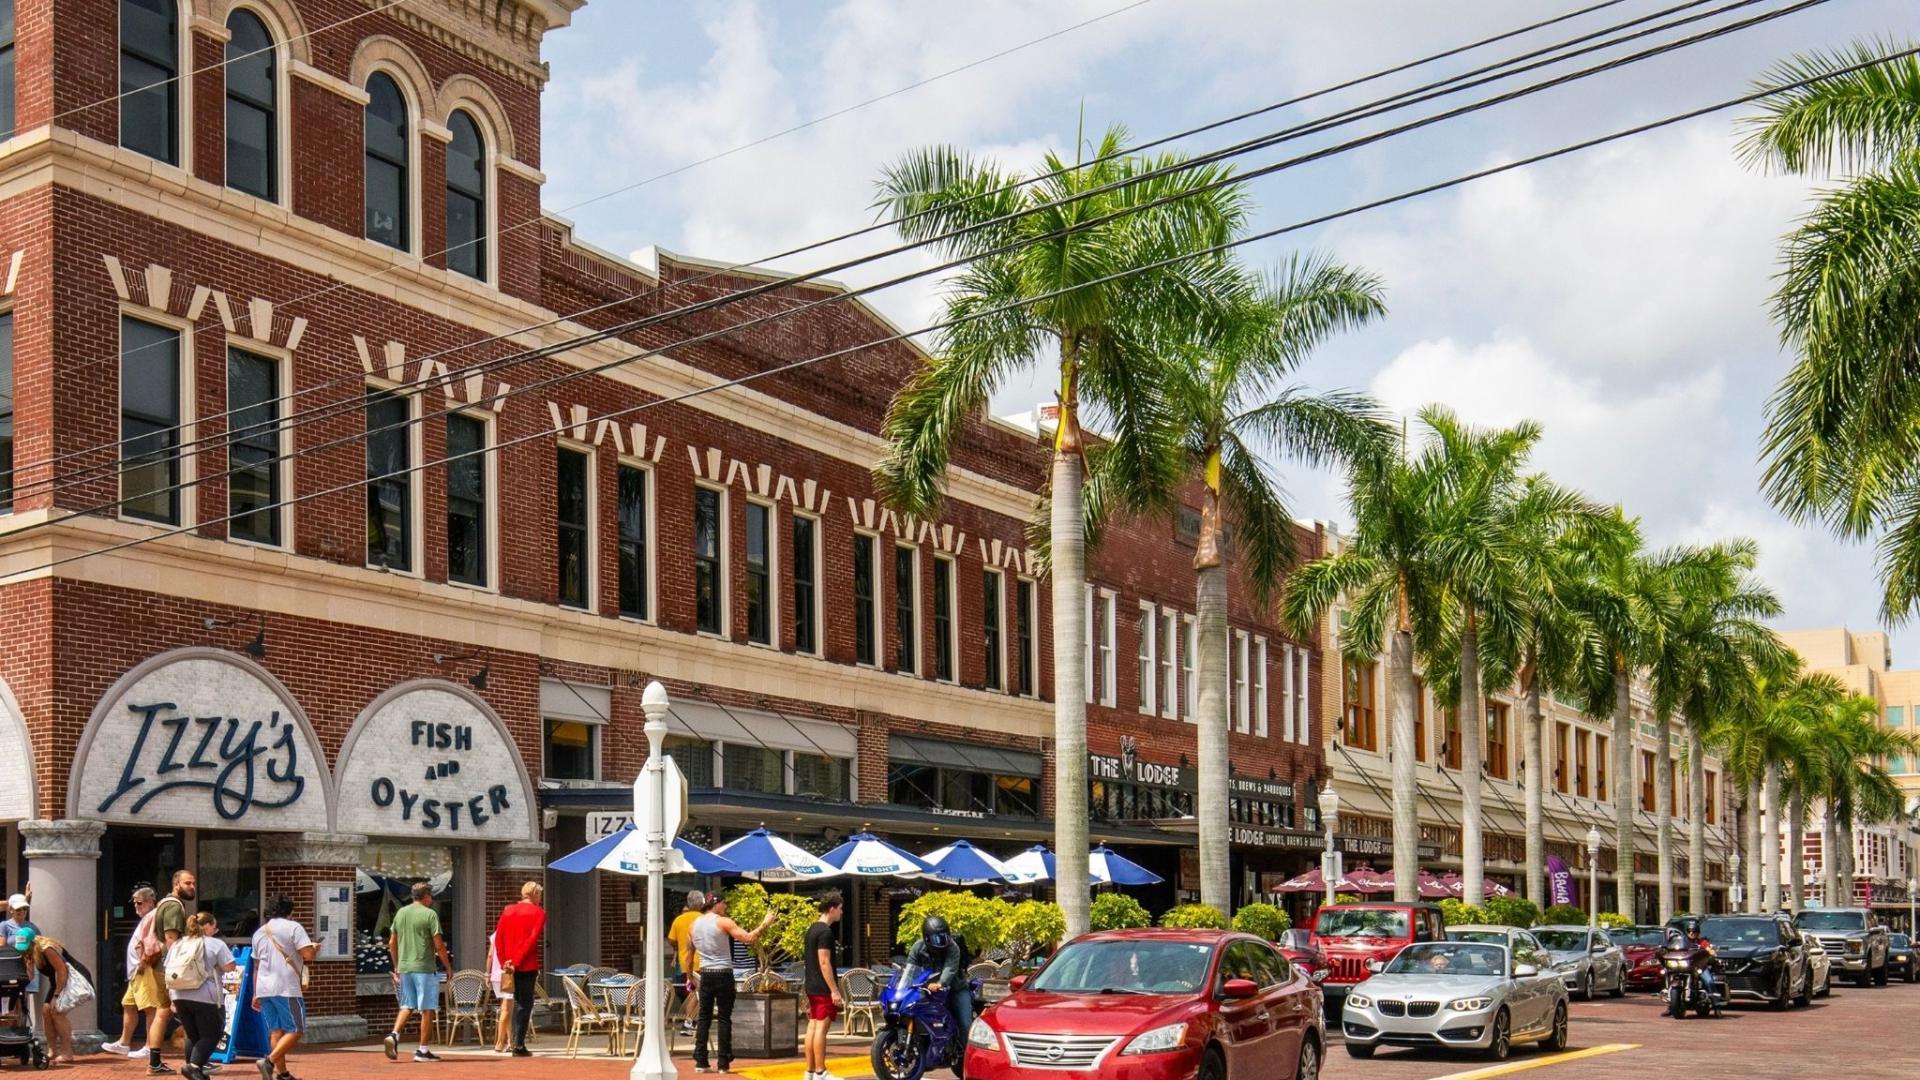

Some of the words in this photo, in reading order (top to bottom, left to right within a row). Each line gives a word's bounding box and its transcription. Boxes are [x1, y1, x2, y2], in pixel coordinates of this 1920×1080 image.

[411, 720, 472, 751] FISH
[98, 702, 304, 820] Izzy's
[425, 760, 460, 780] AND
[1091, 755, 1119, 778] THE
[1137, 763, 1179, 786] LODGE
[371, 777, 510, 831] OYSTER
[594, 816, 634, 834] IZZ
[1235, 828, 1264, 846] LODGE
[1344, 838, 1358, 853] THE
[1360, 839, 1381, 855] LODGE
